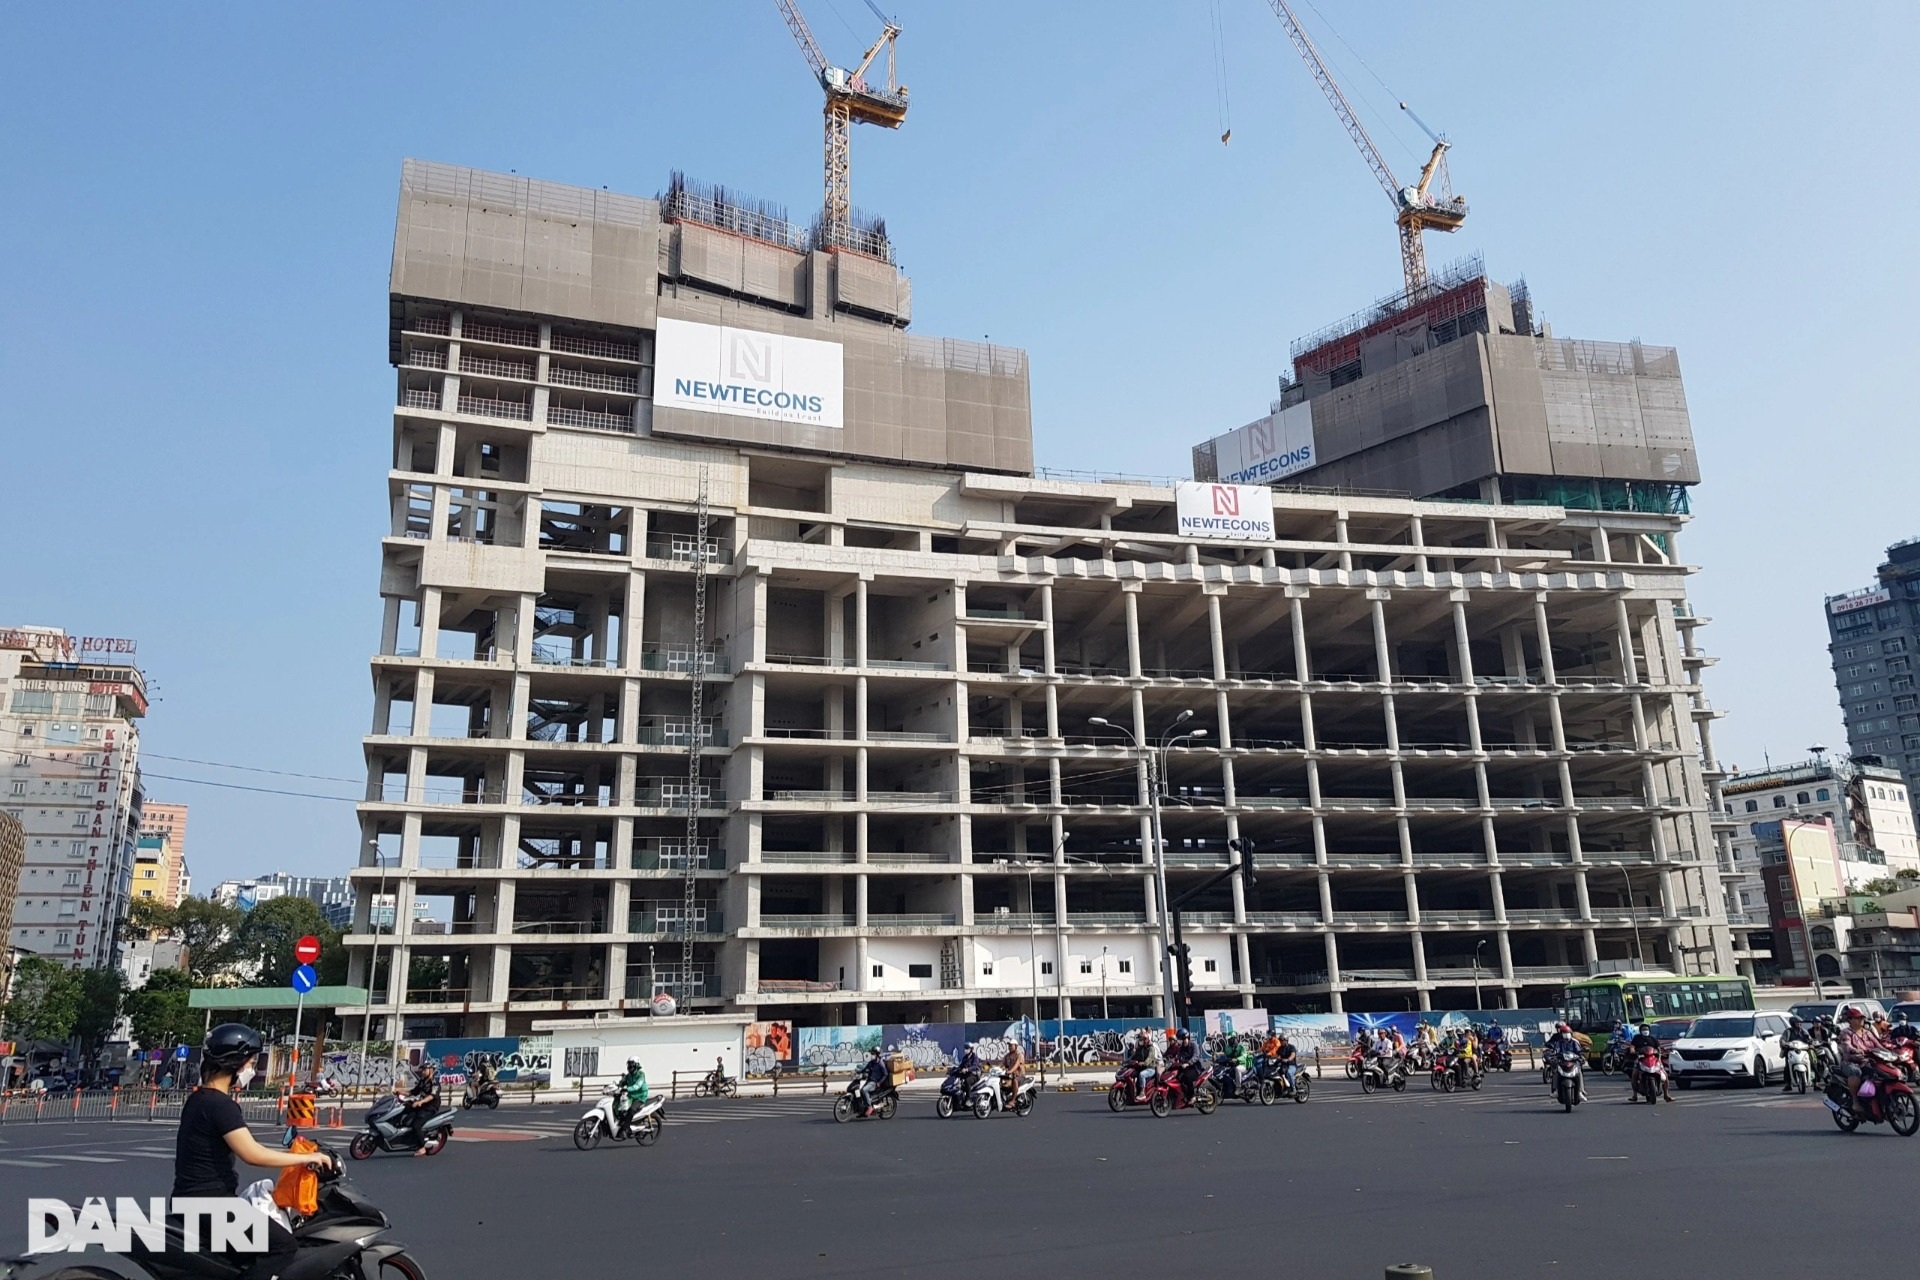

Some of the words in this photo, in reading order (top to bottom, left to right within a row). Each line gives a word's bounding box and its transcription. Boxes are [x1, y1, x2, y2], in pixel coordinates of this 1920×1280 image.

[675, 378, 822, 413] NEWTECONS
[1227, 446, 1310, 483] EWTECONS
[1181, 517, 1271, 532] NEWTECONS
[1837, 603, 1854, 612] 0916
[81, 636, 137, 654] HOTEL
[89, 682, 126, 695] HOTEL
[97, 728, 116, 793] KHÁCH
